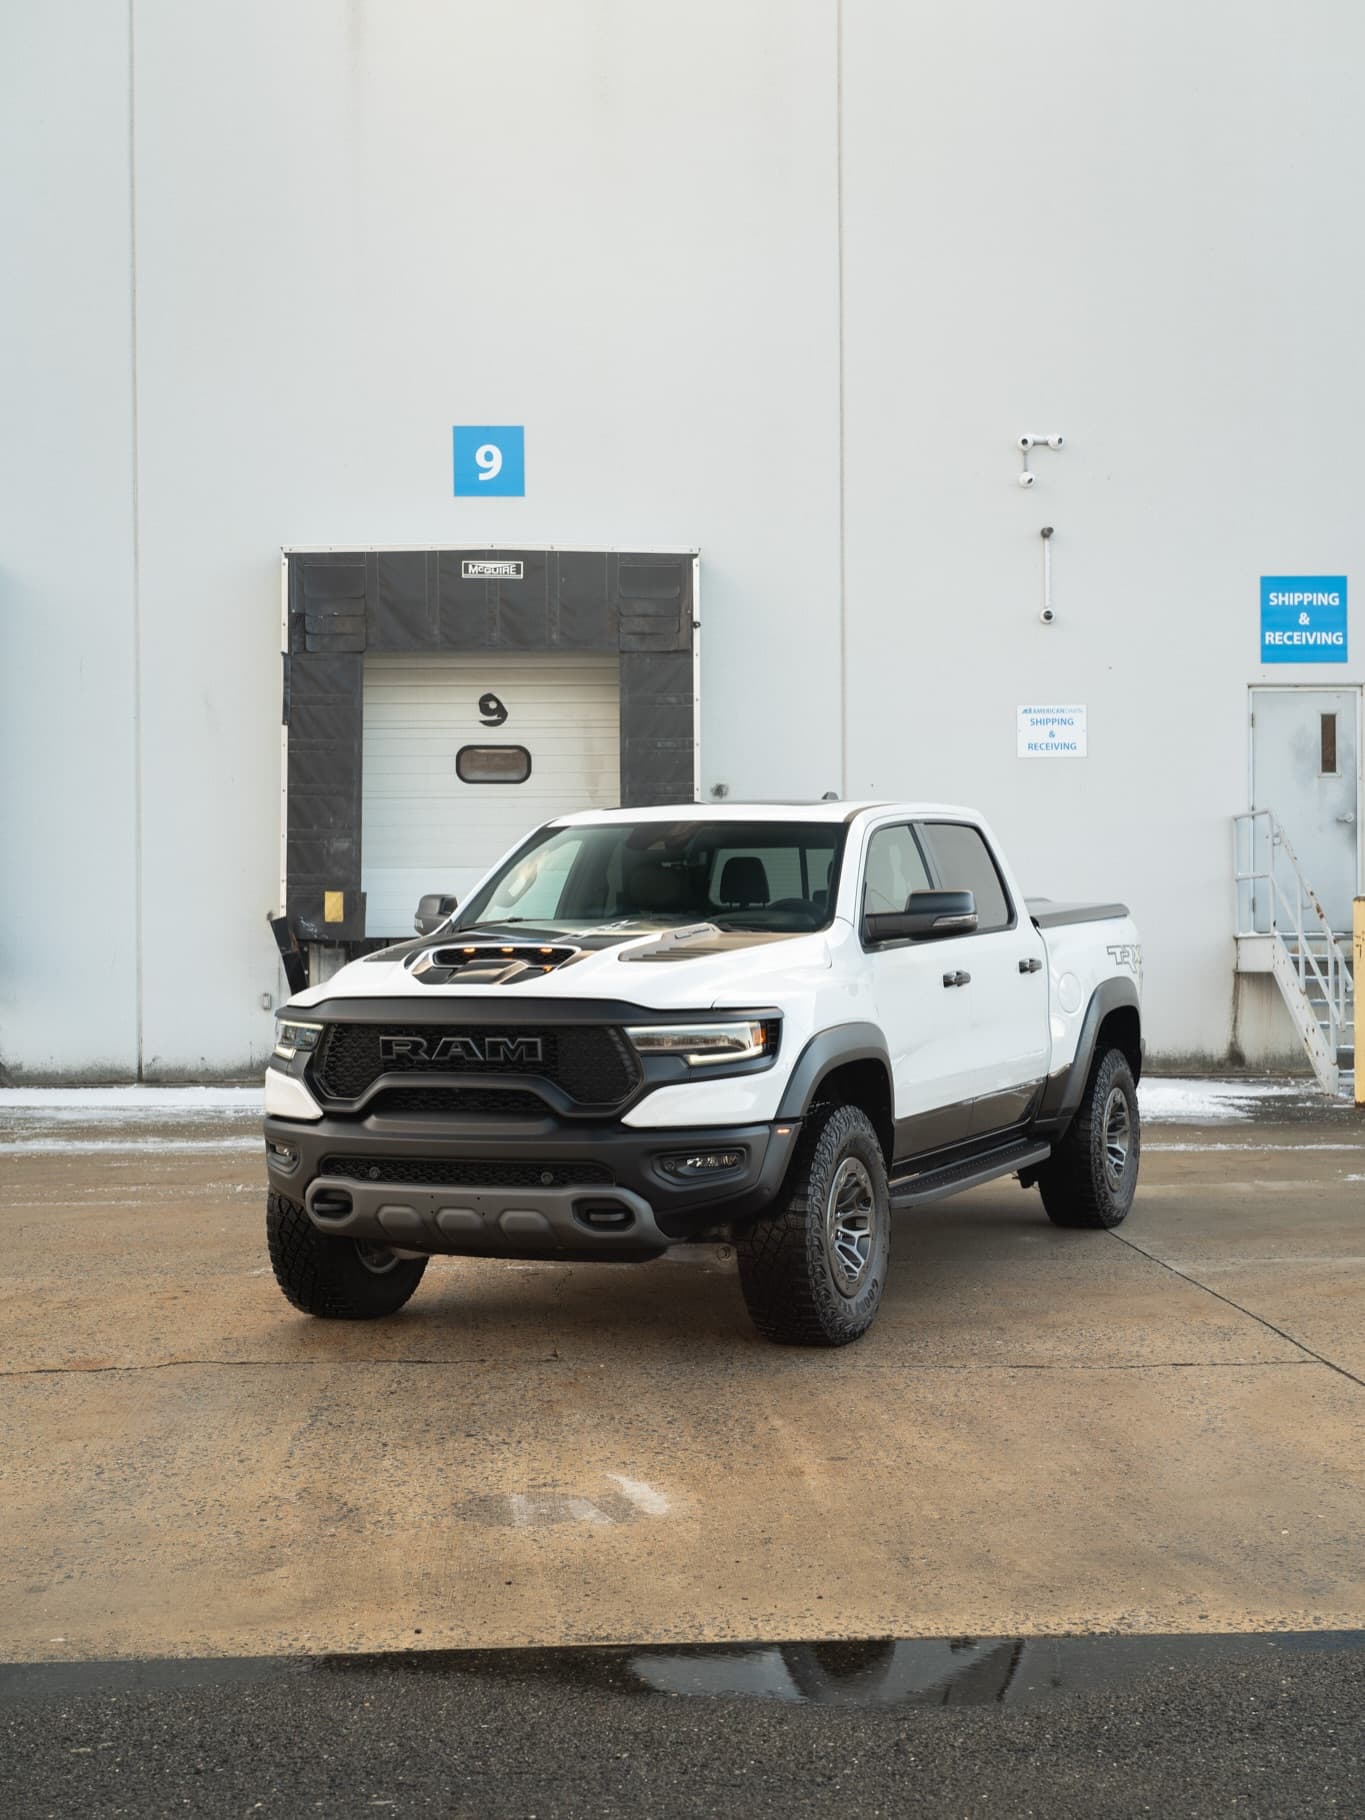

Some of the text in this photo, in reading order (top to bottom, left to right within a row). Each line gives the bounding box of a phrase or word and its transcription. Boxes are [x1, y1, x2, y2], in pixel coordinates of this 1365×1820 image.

[475, 444, 503, 481] 9
[1269, 592, 1340, 606] SHIPPING
[1298, 612, 1310, 625] &
[1265, 632, 1344, 645] RECEIVING
[478, 692, 508, 727] 9
[1030, 717, 1074, 727] SHIPPING
[1048, 730, 1056, 738] &
[1027, 742, 1077, 751] RECEIVING
[379, 1036, 543, 1062] RAM
